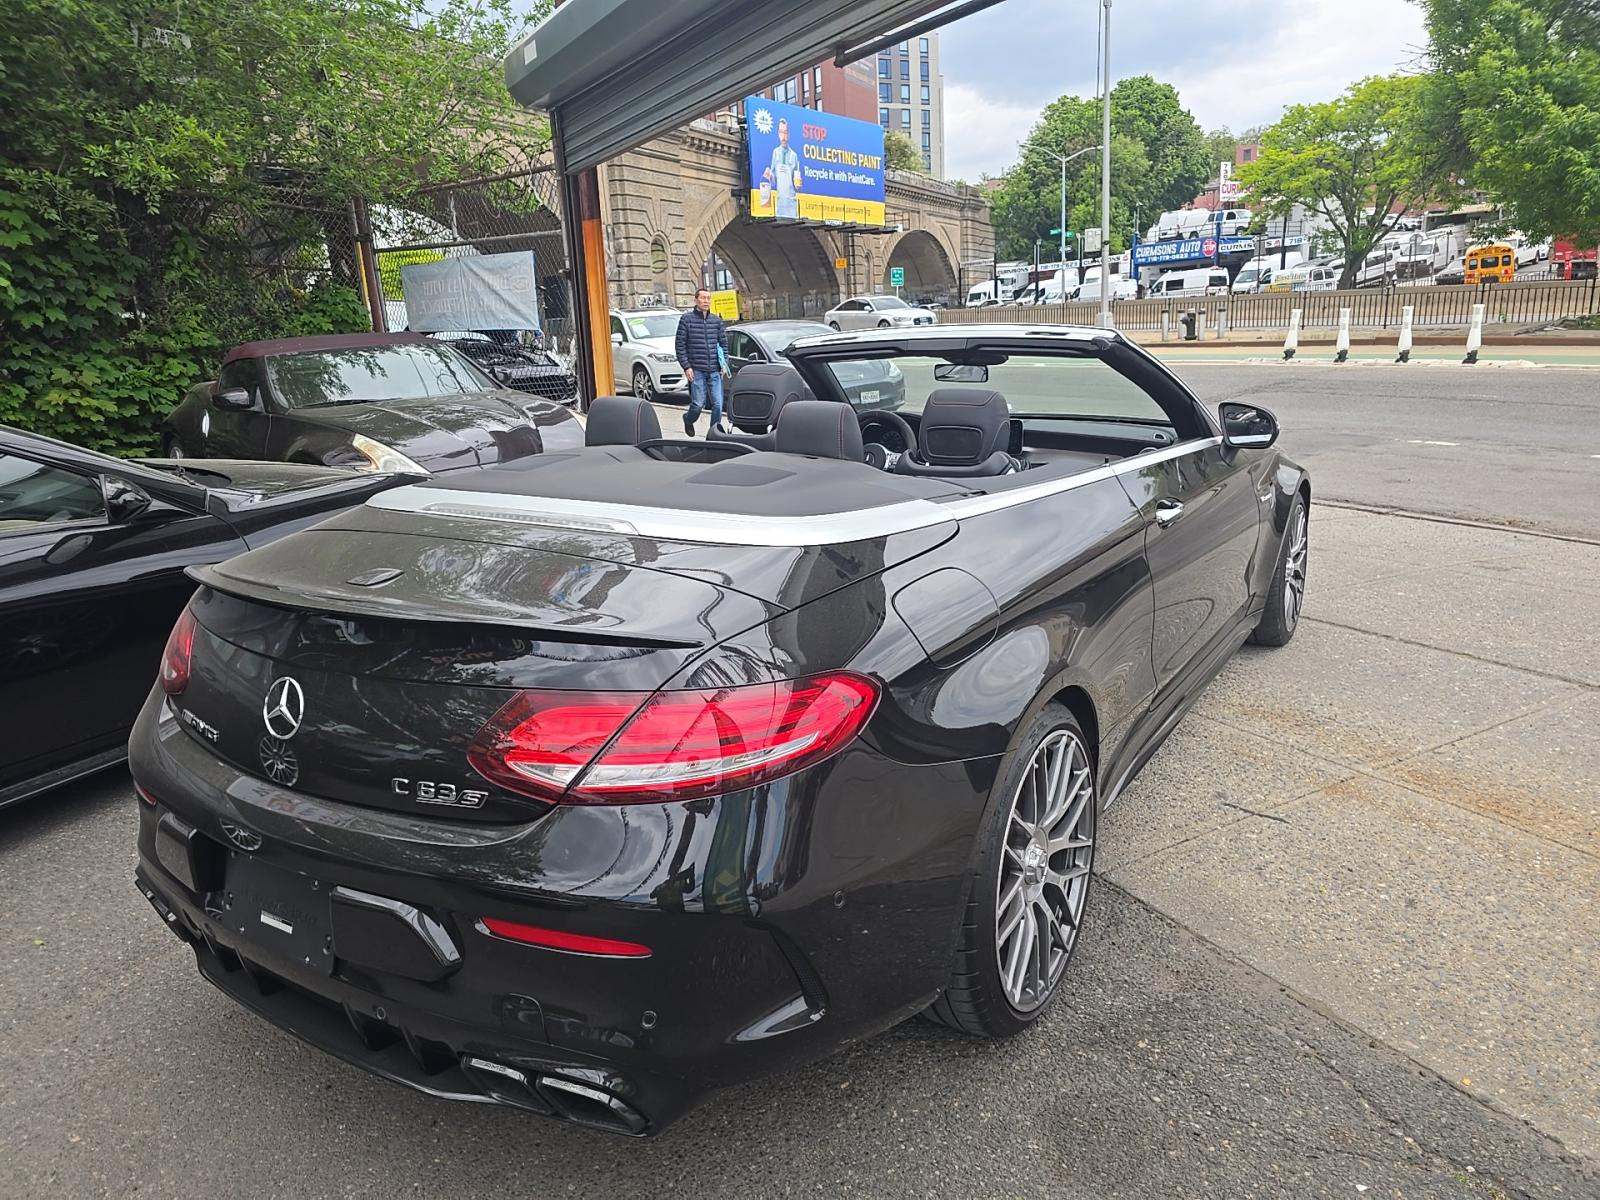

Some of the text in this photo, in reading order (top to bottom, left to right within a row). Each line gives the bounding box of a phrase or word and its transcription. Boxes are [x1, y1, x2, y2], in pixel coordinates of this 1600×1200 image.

[803, 123, 827, 139] STOP
[804, 144, 881, 170] COLLECTING PAINT
[805, 166, 828, 180] Recycle
[829, 169, 834, 180] it
[835, 171, 847, 182] with
[1135, 241, 1200, 258] CURMSONS AUTO
[392, 778, 409, 794] C
